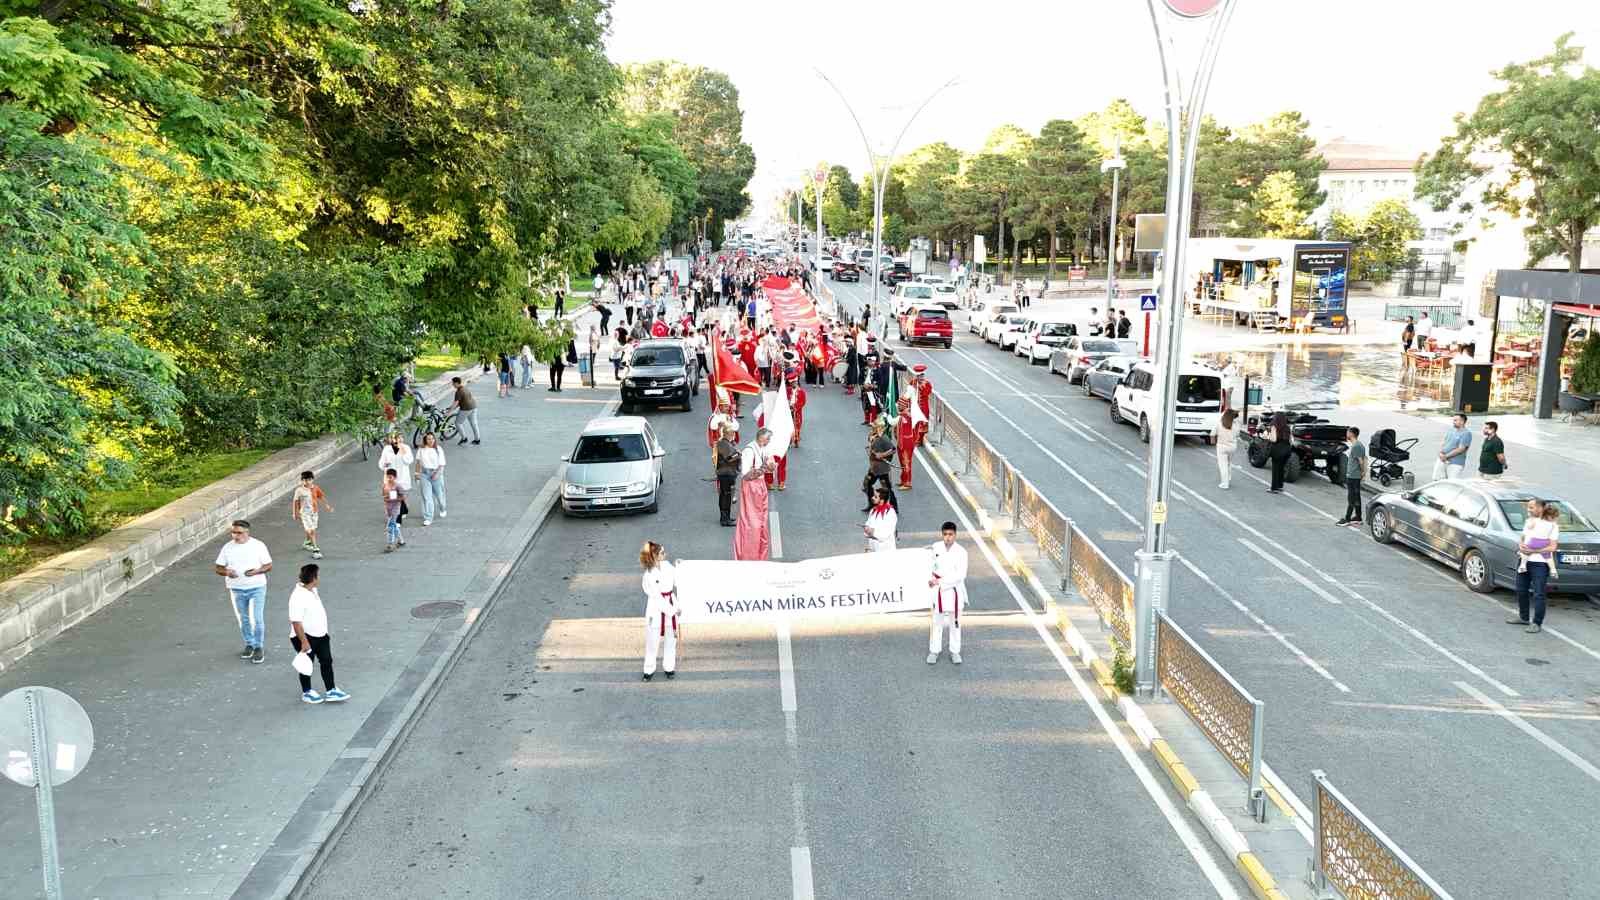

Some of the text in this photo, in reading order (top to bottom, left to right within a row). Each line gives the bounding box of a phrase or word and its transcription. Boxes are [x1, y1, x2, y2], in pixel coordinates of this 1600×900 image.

[706, 586, 904, 616] YAŞAYAN MİRAS FESTİVALİ
